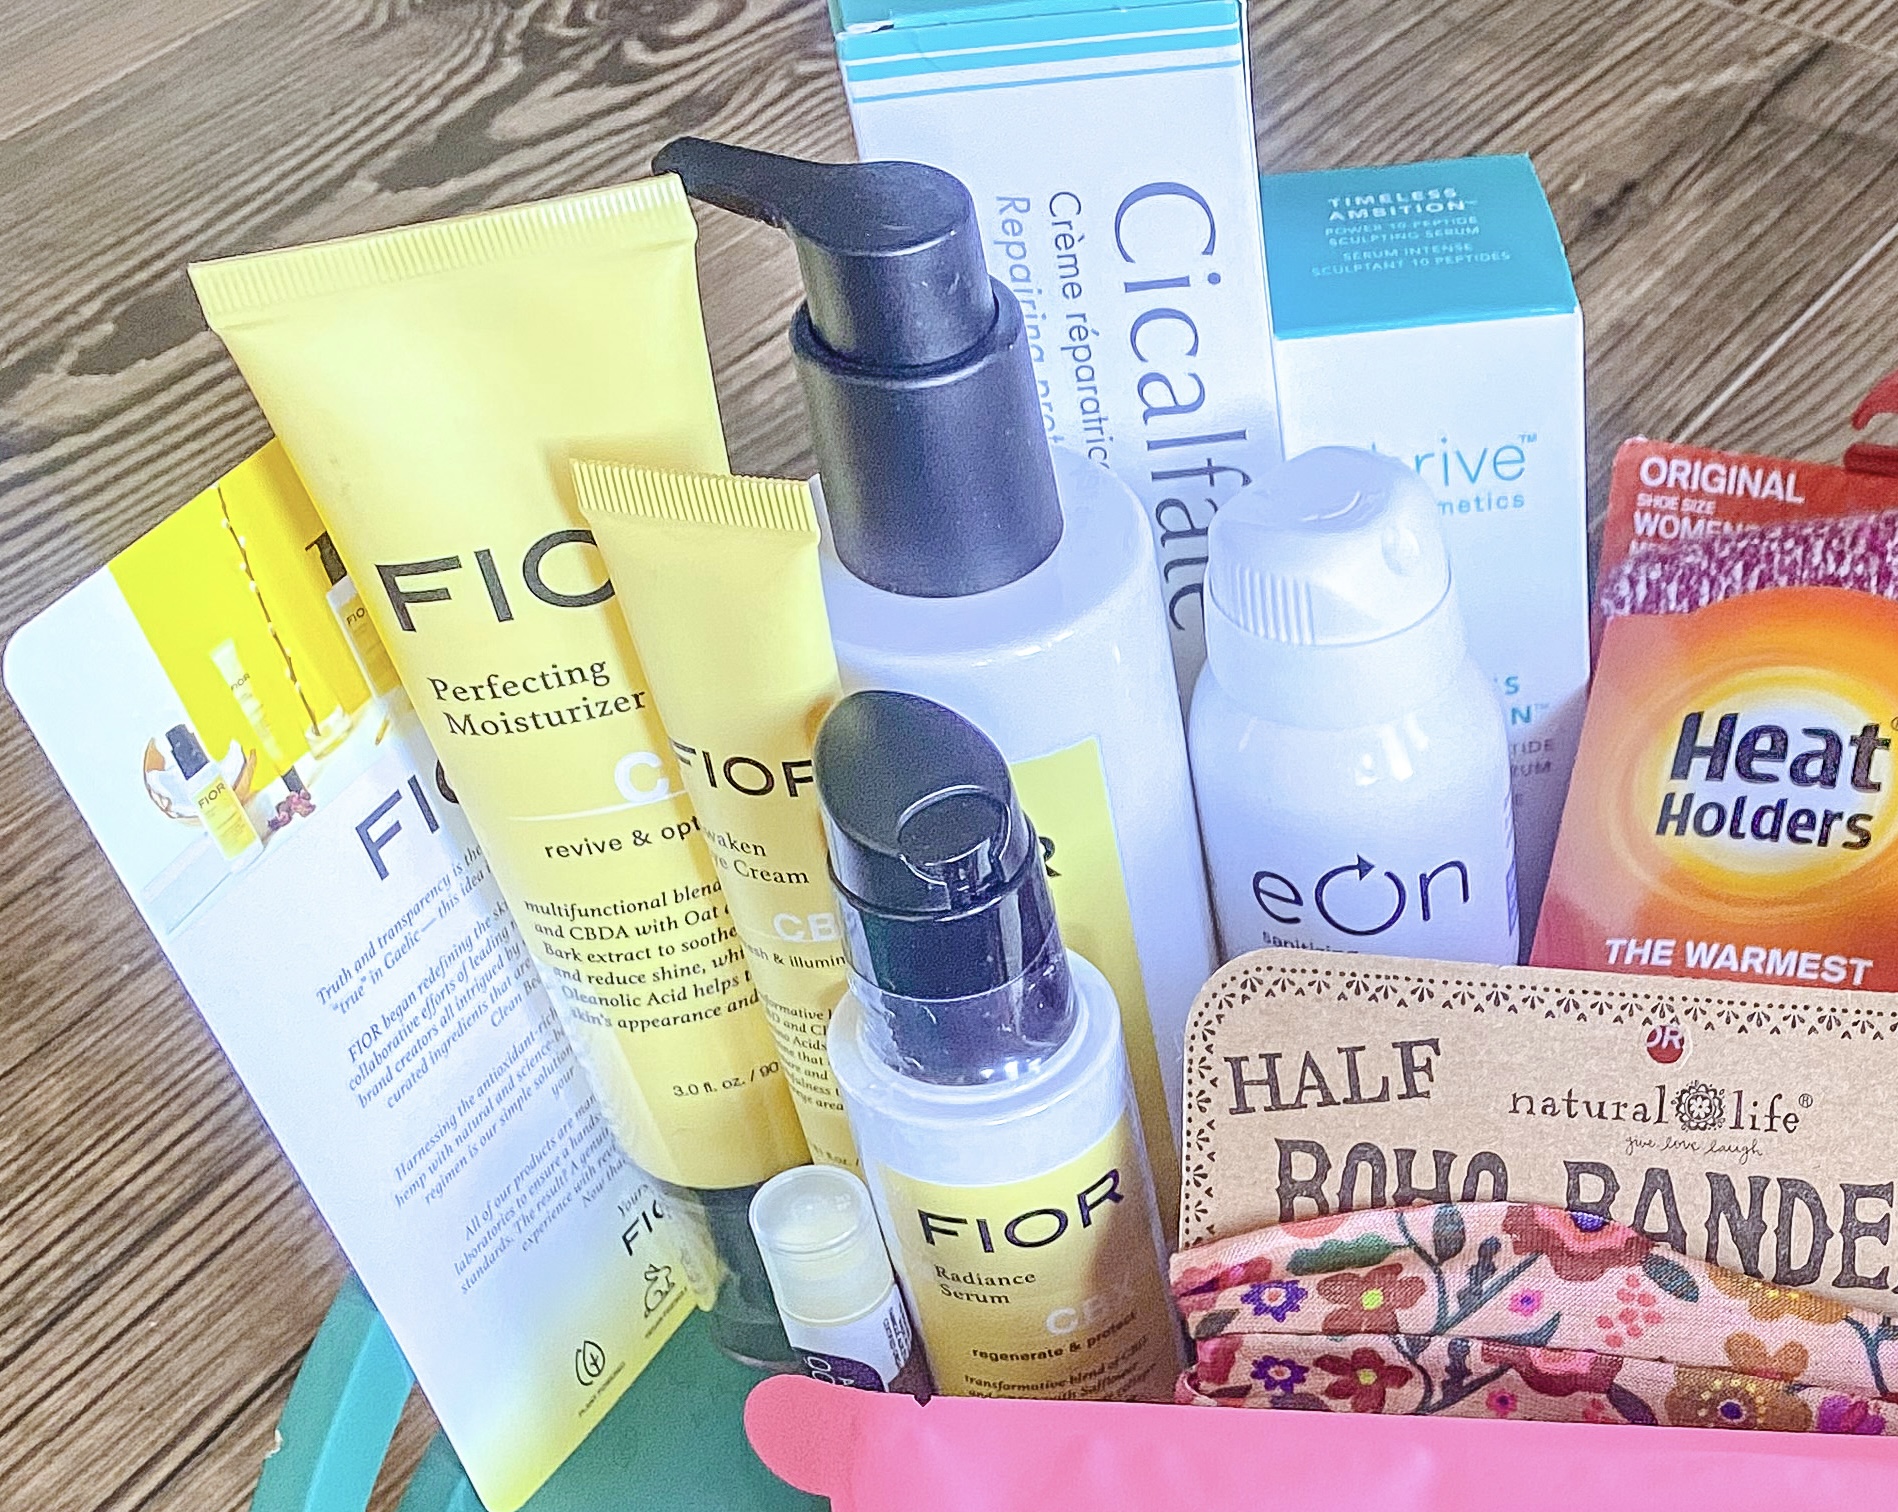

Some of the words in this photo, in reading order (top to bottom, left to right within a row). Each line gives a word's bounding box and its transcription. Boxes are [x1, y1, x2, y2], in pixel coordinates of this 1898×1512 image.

[1328, 187, 1457, 208] TIMELESS
[1329, 200, 1465, 221] AMBITION
[1049, 191, 1082, 300] Crème
[1640, 456, 1806, 504] ORIGINAL
[427, 656, 611, 706] Perfecting
[442, 687, 648, 738] Moisturizer
[1654, 791, 1874, 851] Holders
[544, 837, 623, 859] revive
[631, 830, 653, 846] &
[734, 859, 809, 884] Cream
[524, 892, 668, 921] multifunctional
[316, 968, 352, 1006] Truth
[354, 941, 375, 972] and
[377, 875, 451, 948] transparency
[1605, 937, 1674, 966] THE
[1684, 940, 1874, 985] WARMEST
[588, 971, 647, 985] reduce
[652, 962, 707, 983] shine,
[1224, 1038, 1443, 1116] HALF
[1508, 1081, 1671, 1126] natural
[918, 1168, 1124, 1253] FIOR
[934, 1264, 1037, 1288] Radiance
[939, 1284, 1011, 1305] Serum
